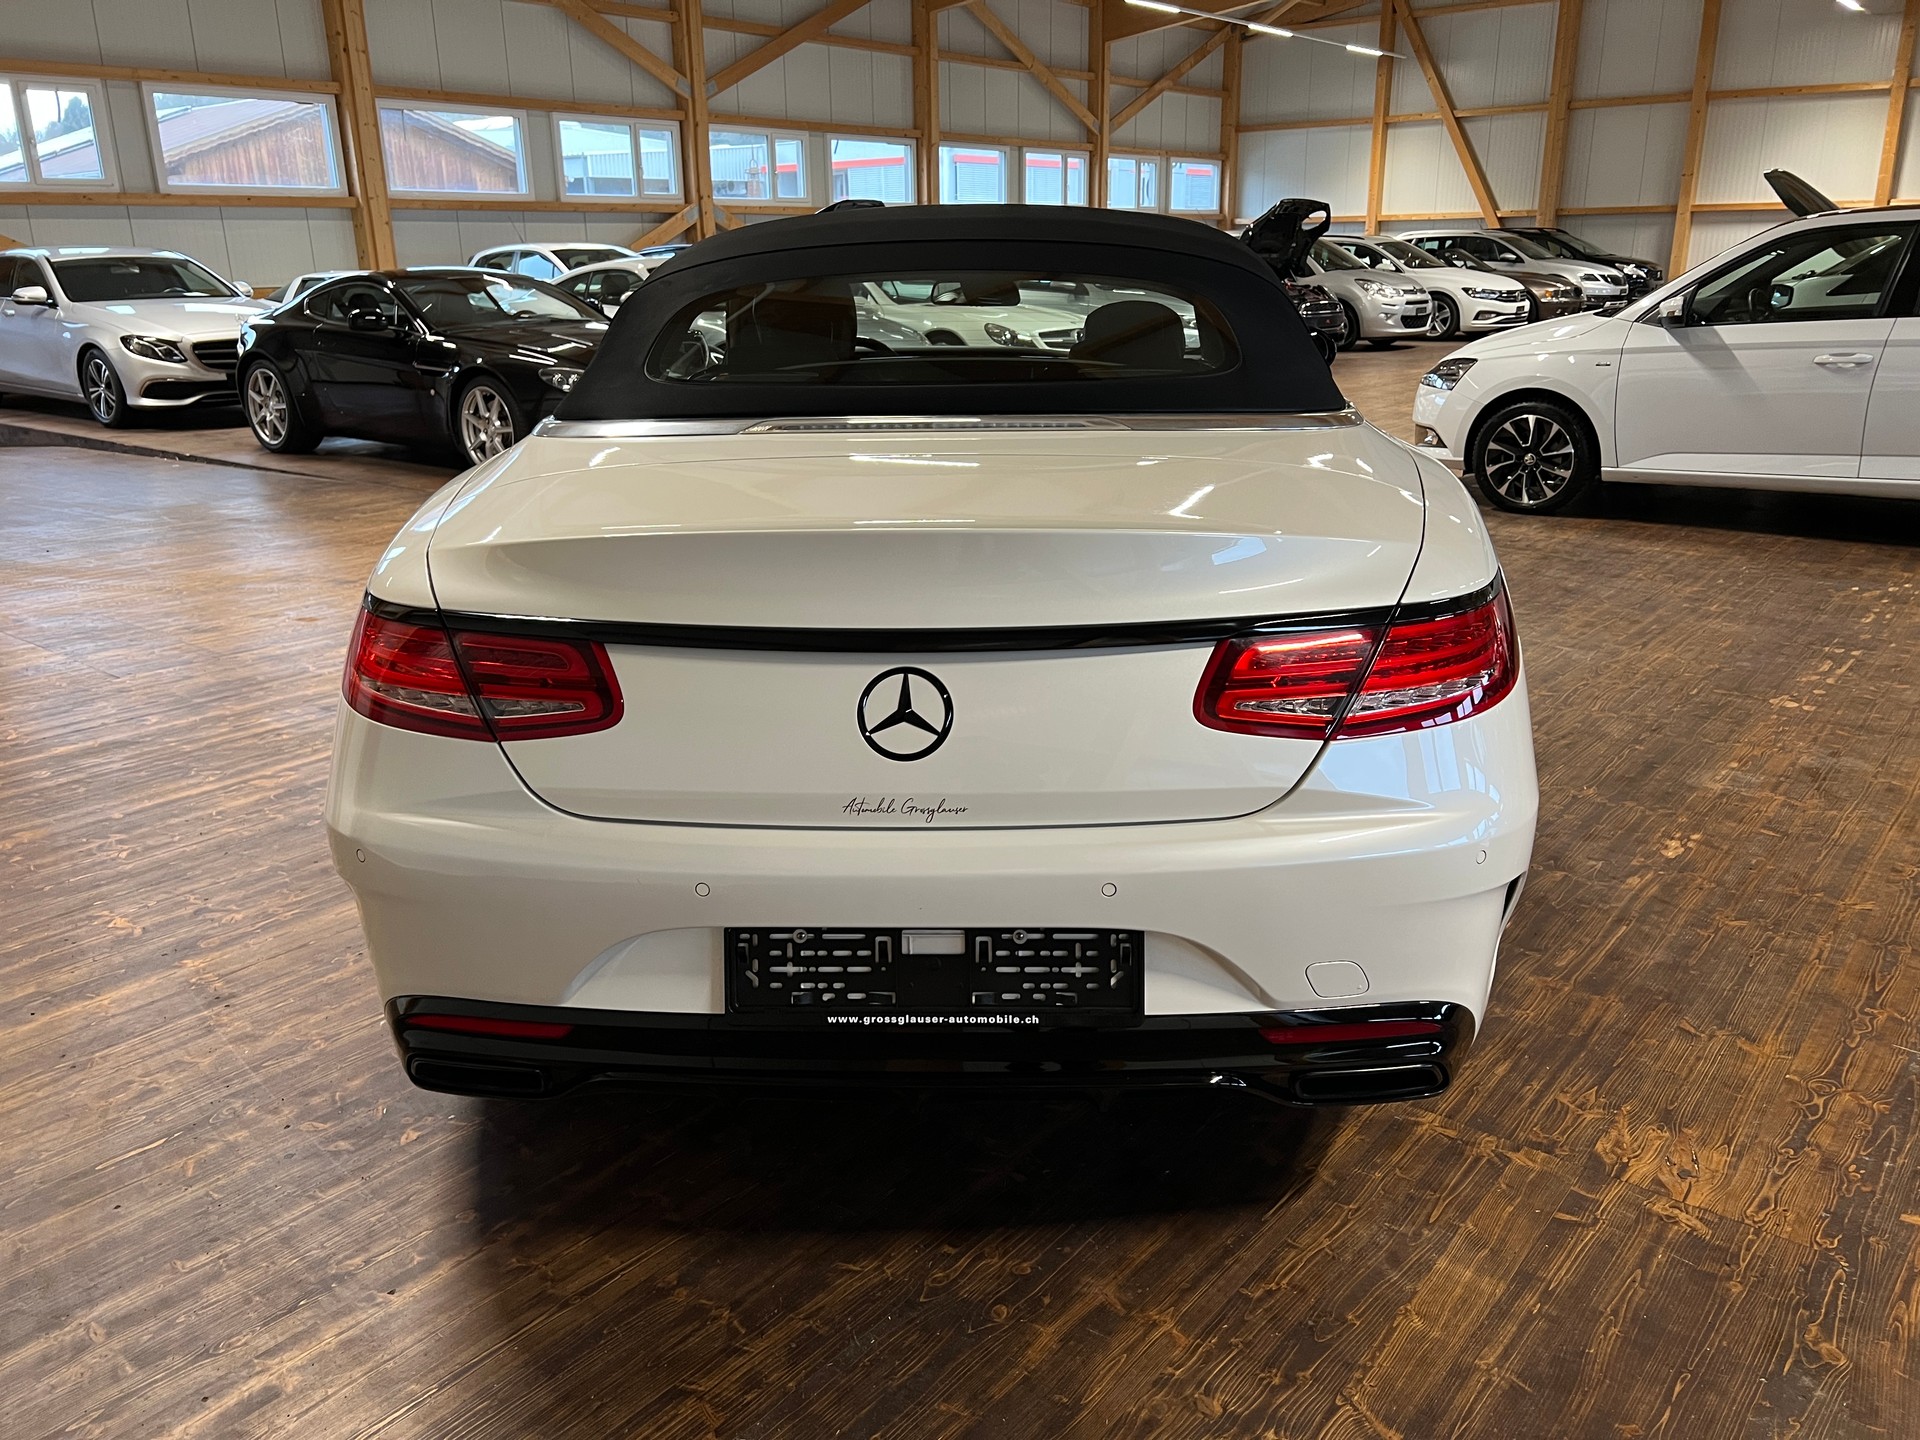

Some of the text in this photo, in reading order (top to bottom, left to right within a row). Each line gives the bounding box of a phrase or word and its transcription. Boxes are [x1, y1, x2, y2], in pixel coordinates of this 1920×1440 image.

[842, 797, 968, 824] Automobile Grossglauser
[827, 1014, 1040, 1026] www.grossglauser-automobile.ch
